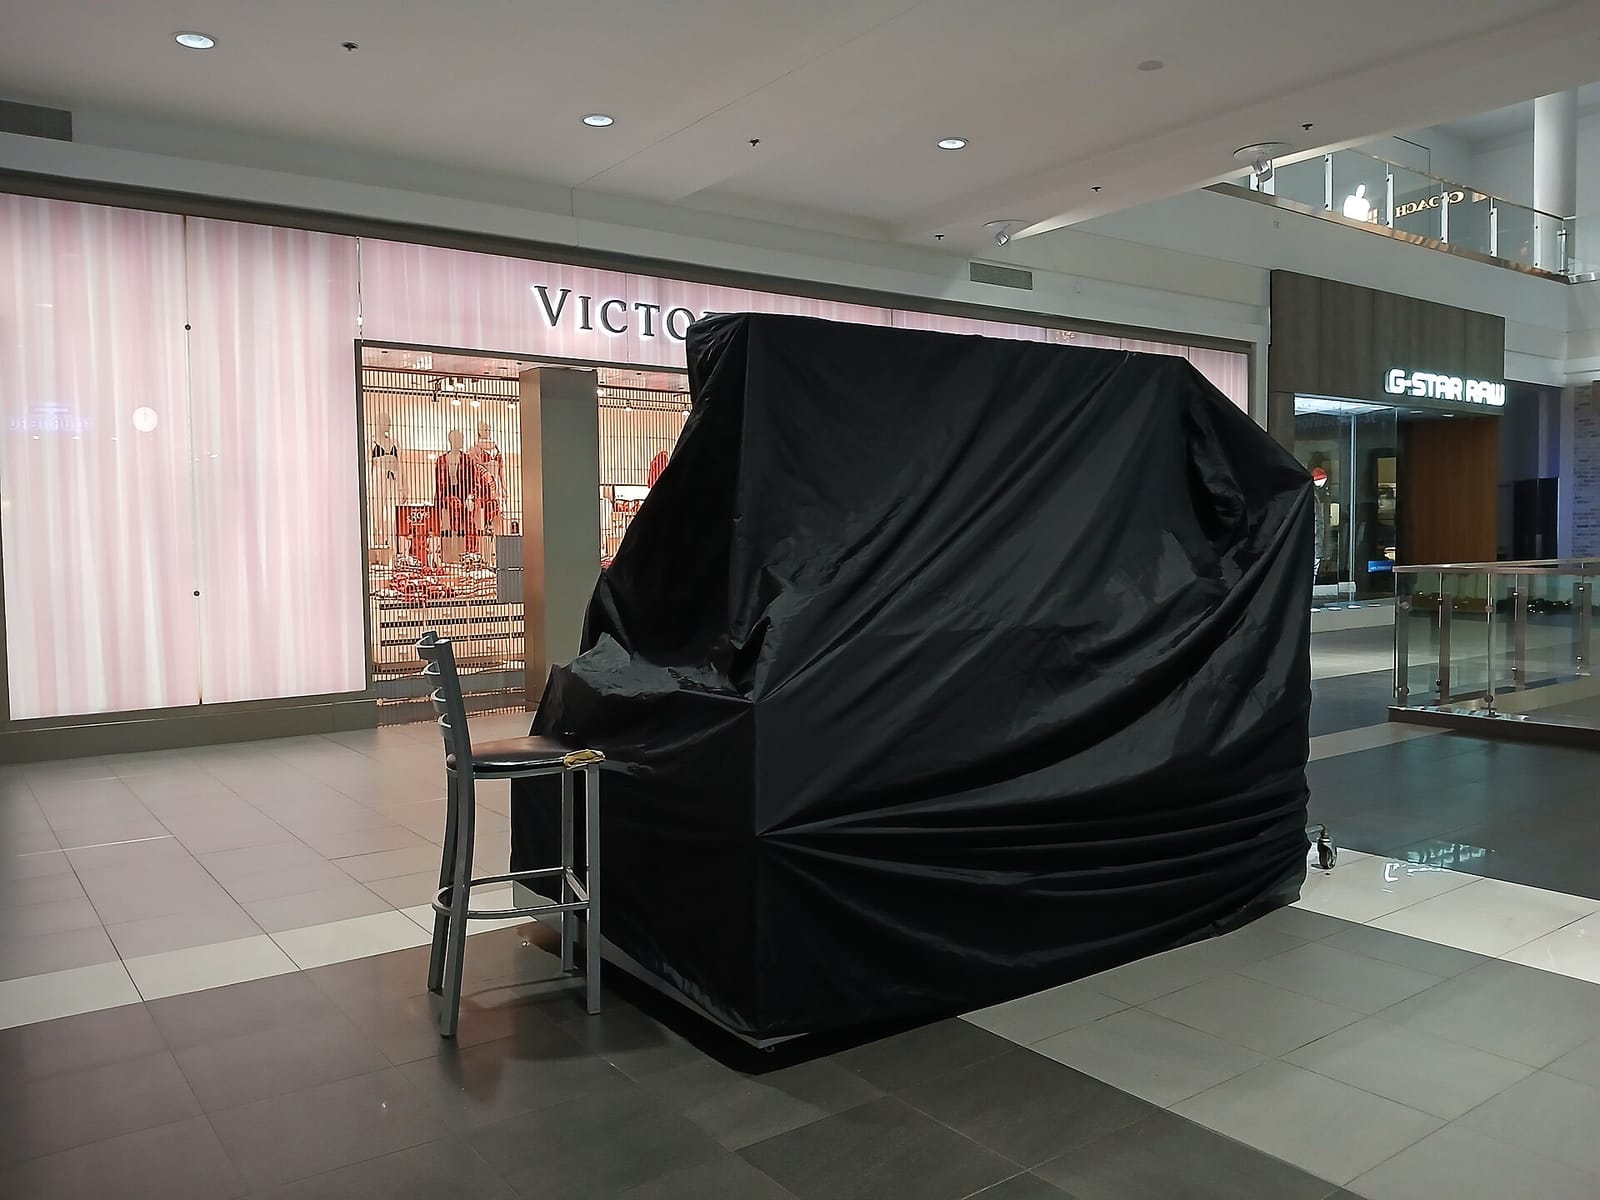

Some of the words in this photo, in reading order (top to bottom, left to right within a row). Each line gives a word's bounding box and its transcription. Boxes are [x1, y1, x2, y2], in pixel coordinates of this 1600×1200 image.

[534, 285, 709, 341] VICTO
[1385, 367, 1462, 400] G-STAR
[1465, 378, 1506, 406] RAW
